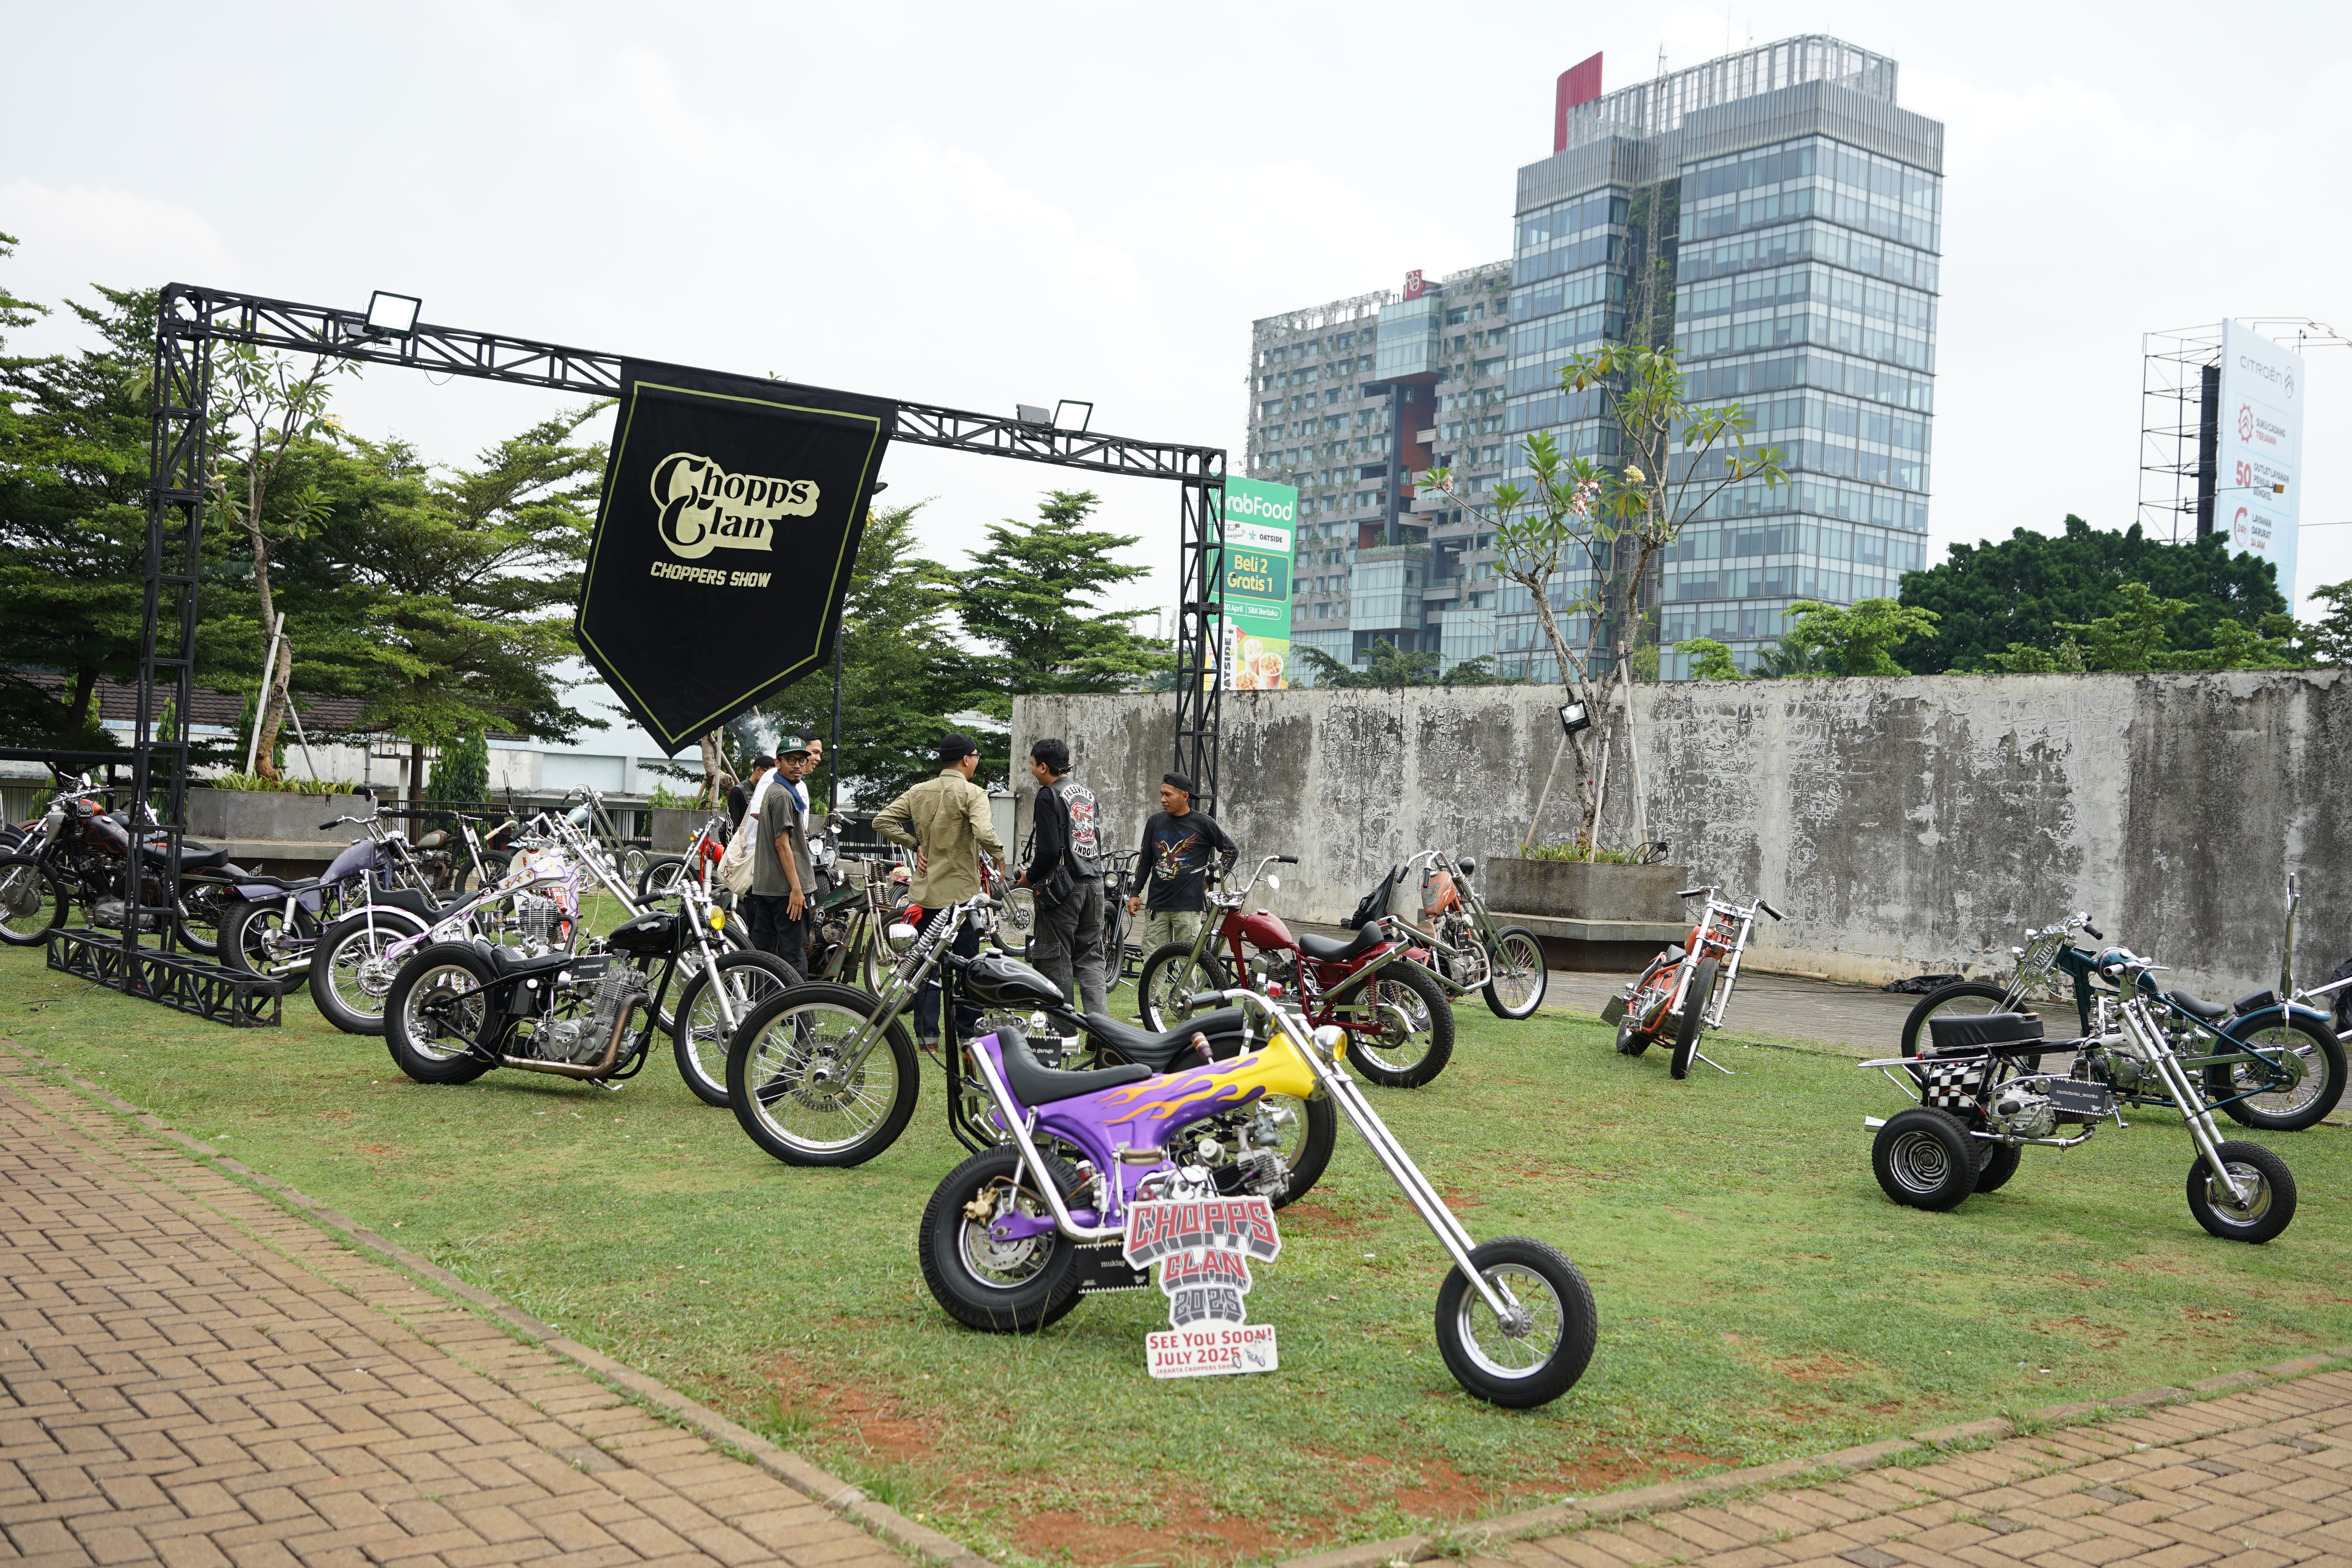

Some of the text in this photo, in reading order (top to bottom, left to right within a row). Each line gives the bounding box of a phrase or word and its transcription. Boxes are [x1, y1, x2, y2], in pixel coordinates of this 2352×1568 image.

[2256, 418, 2286, 437] SUKU CADANG
[2256, 430, 2277, 446] TERJAMIN
[2236, 460, 2252, 488] 50
[2254, 462, 2290, 483] OUTLET LAYANAN
[654, 457, 810, 508] Chopps
[2254, 487, 2272, 501] BENGKEL
[662, 495, 765, 546] Clan
[2238, 524, 2247, 534] 24h
[2252, 513, 2272, 528] LAYANAN
[1259, 534, 1283, 543] OATSIDE
[2252, 525, 2272, 540] DARURAT
[2251, 537, 2265, 550] 24 JAM
[1234, 554, 1268, 573] Beli 2
[650, 561, 771, 587] CHOPPERS SHOW
[1227, 572, 1272, 592] Gratis 1
[1231, 604, 1243, 613] April
[1248, 606, 1278, 617] S&K Berlaku
[1063, 786, 1092, 801] FREEVETS
[2056, 1090, 2098, 1099] motoboto_works
[1128, 1201, 1278, 1265] CHOPPS
[1101, 1259, 1126, 1268] muklay
[1163, 1249, 1249, 1292] CLAN
[1174, 1289, 1243, 1327] 2025
[1149, 1328, 1272, 1349] SEE YOU SOON!
[1156, 1347, 1241, 1366] JULY 2025
